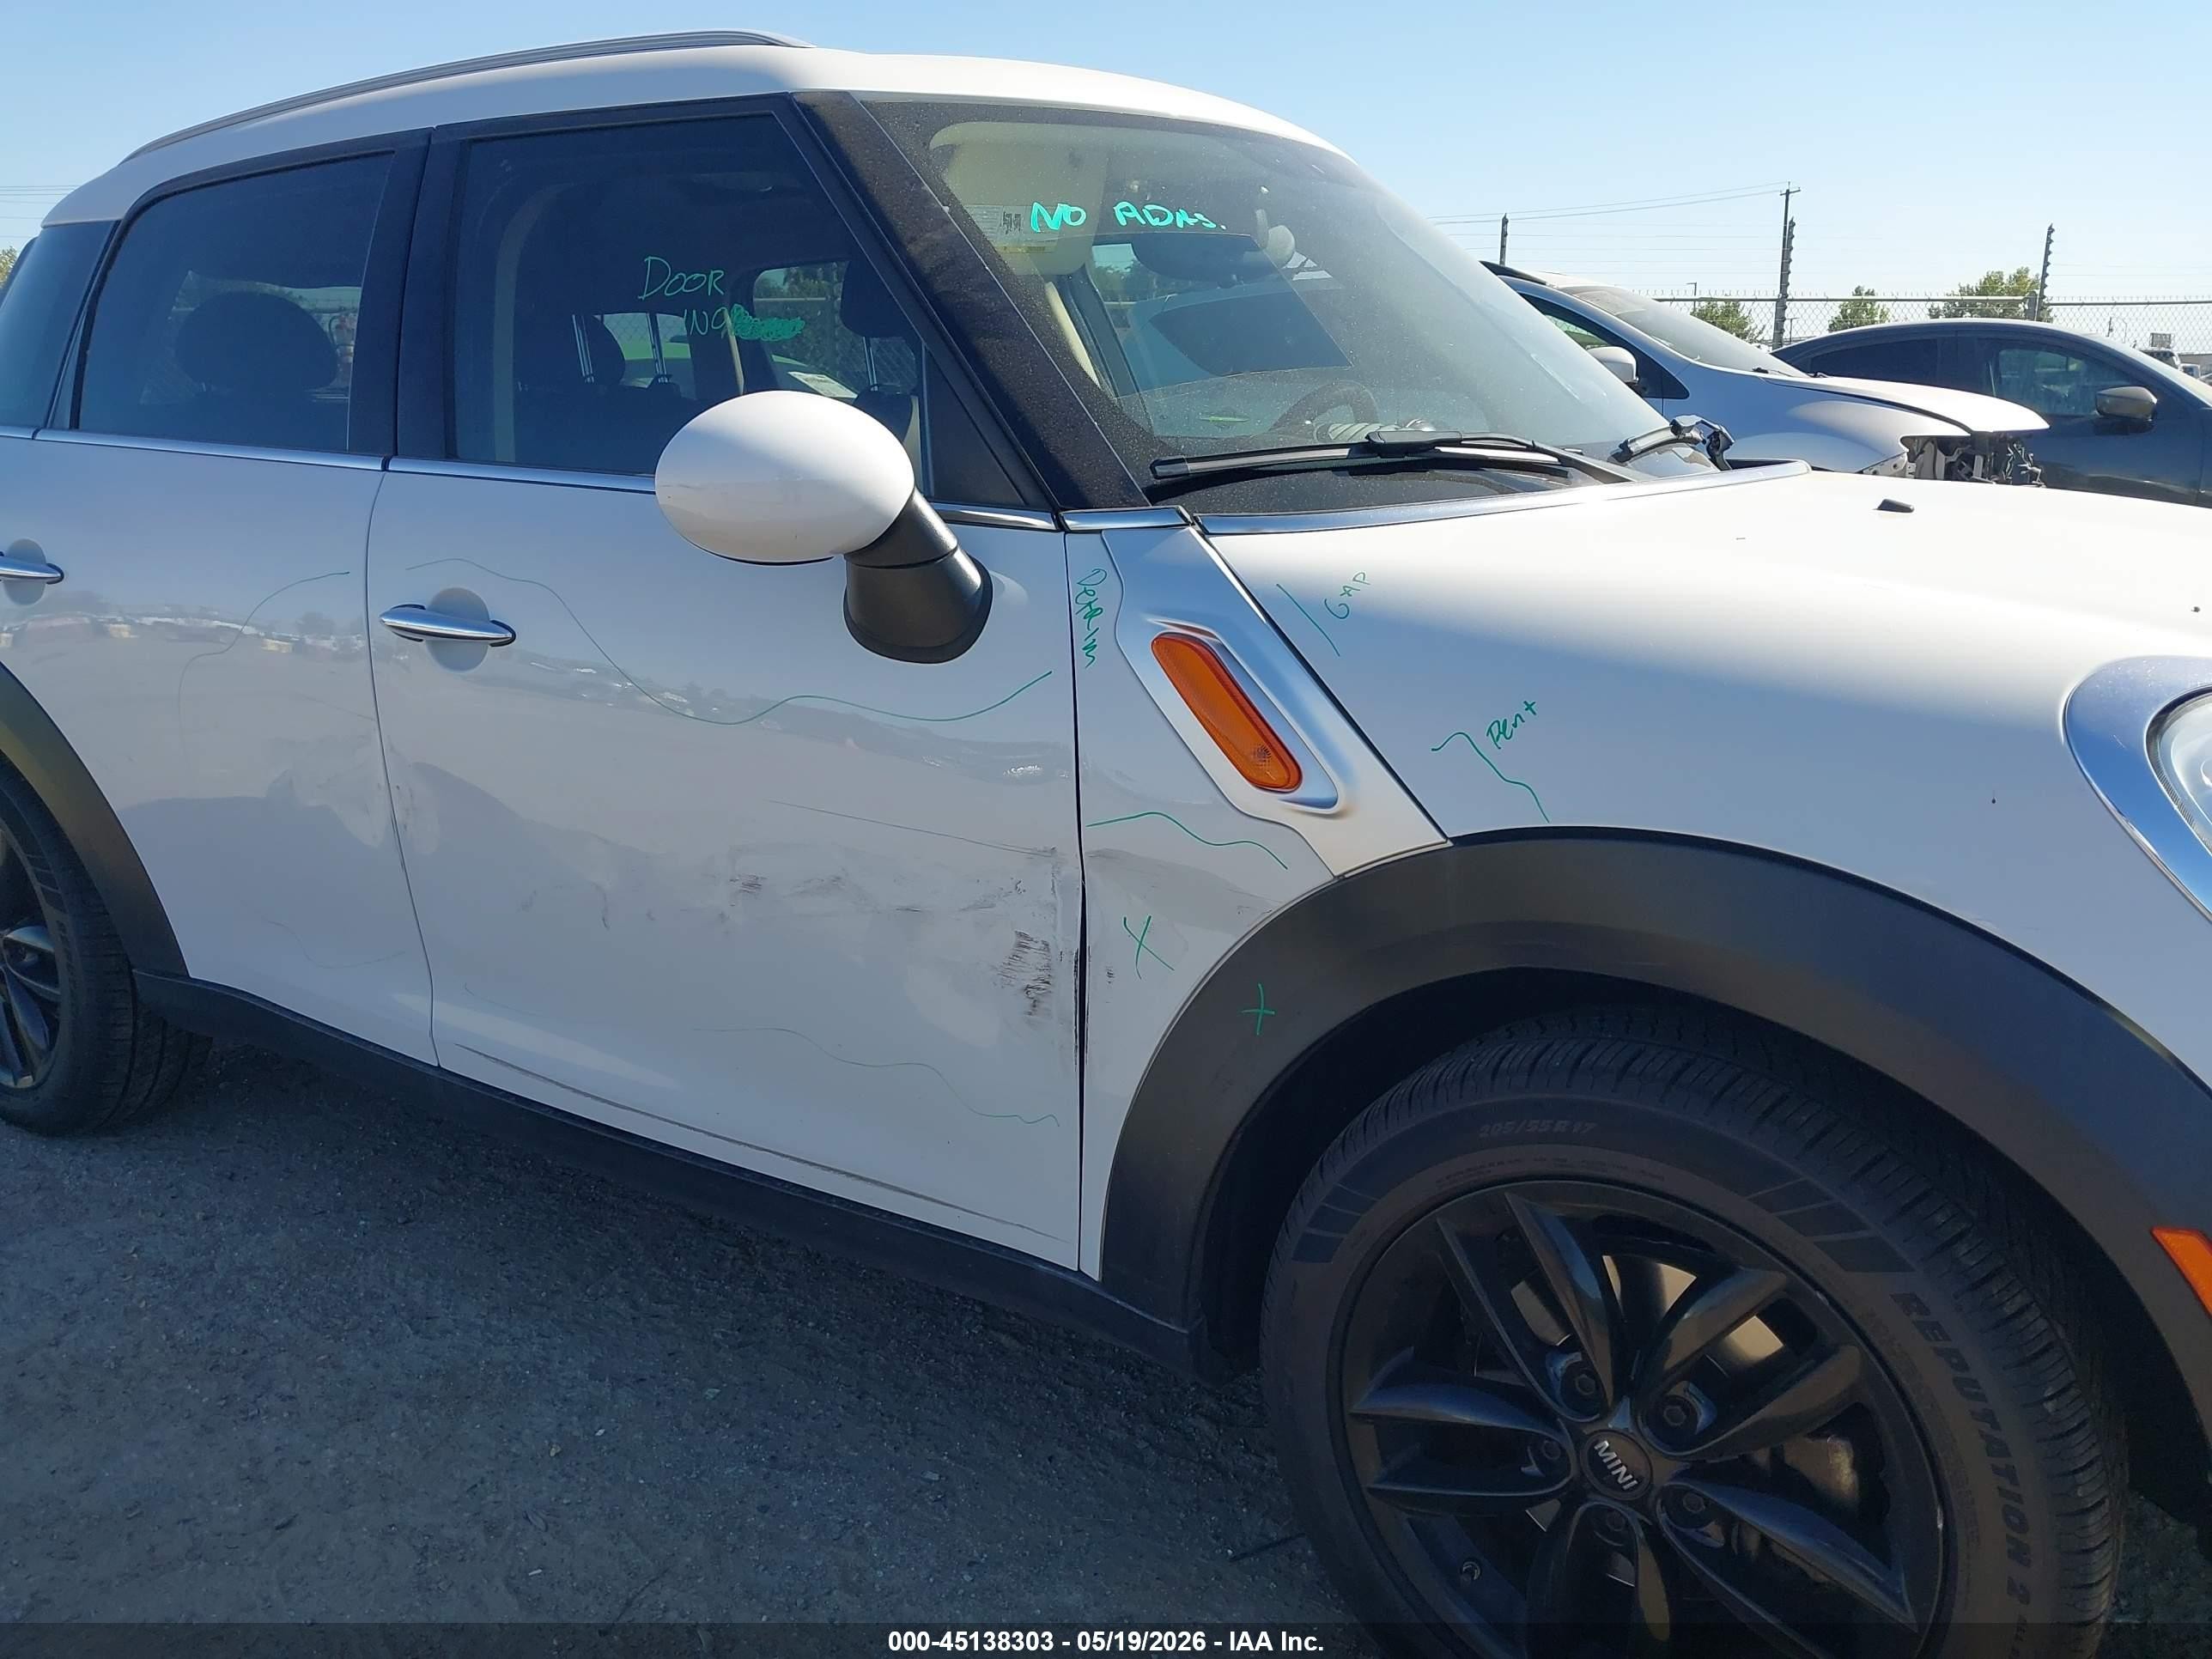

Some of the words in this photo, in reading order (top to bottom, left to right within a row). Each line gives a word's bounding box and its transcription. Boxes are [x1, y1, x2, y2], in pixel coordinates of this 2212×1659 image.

[1030, 202, 1087, 233] NO
[1323, 570, 1371, 619] GAP
[1890, 1291, 2033, 1569] REPUTATION
[1594, 1440, 1638, 1491] MINI
